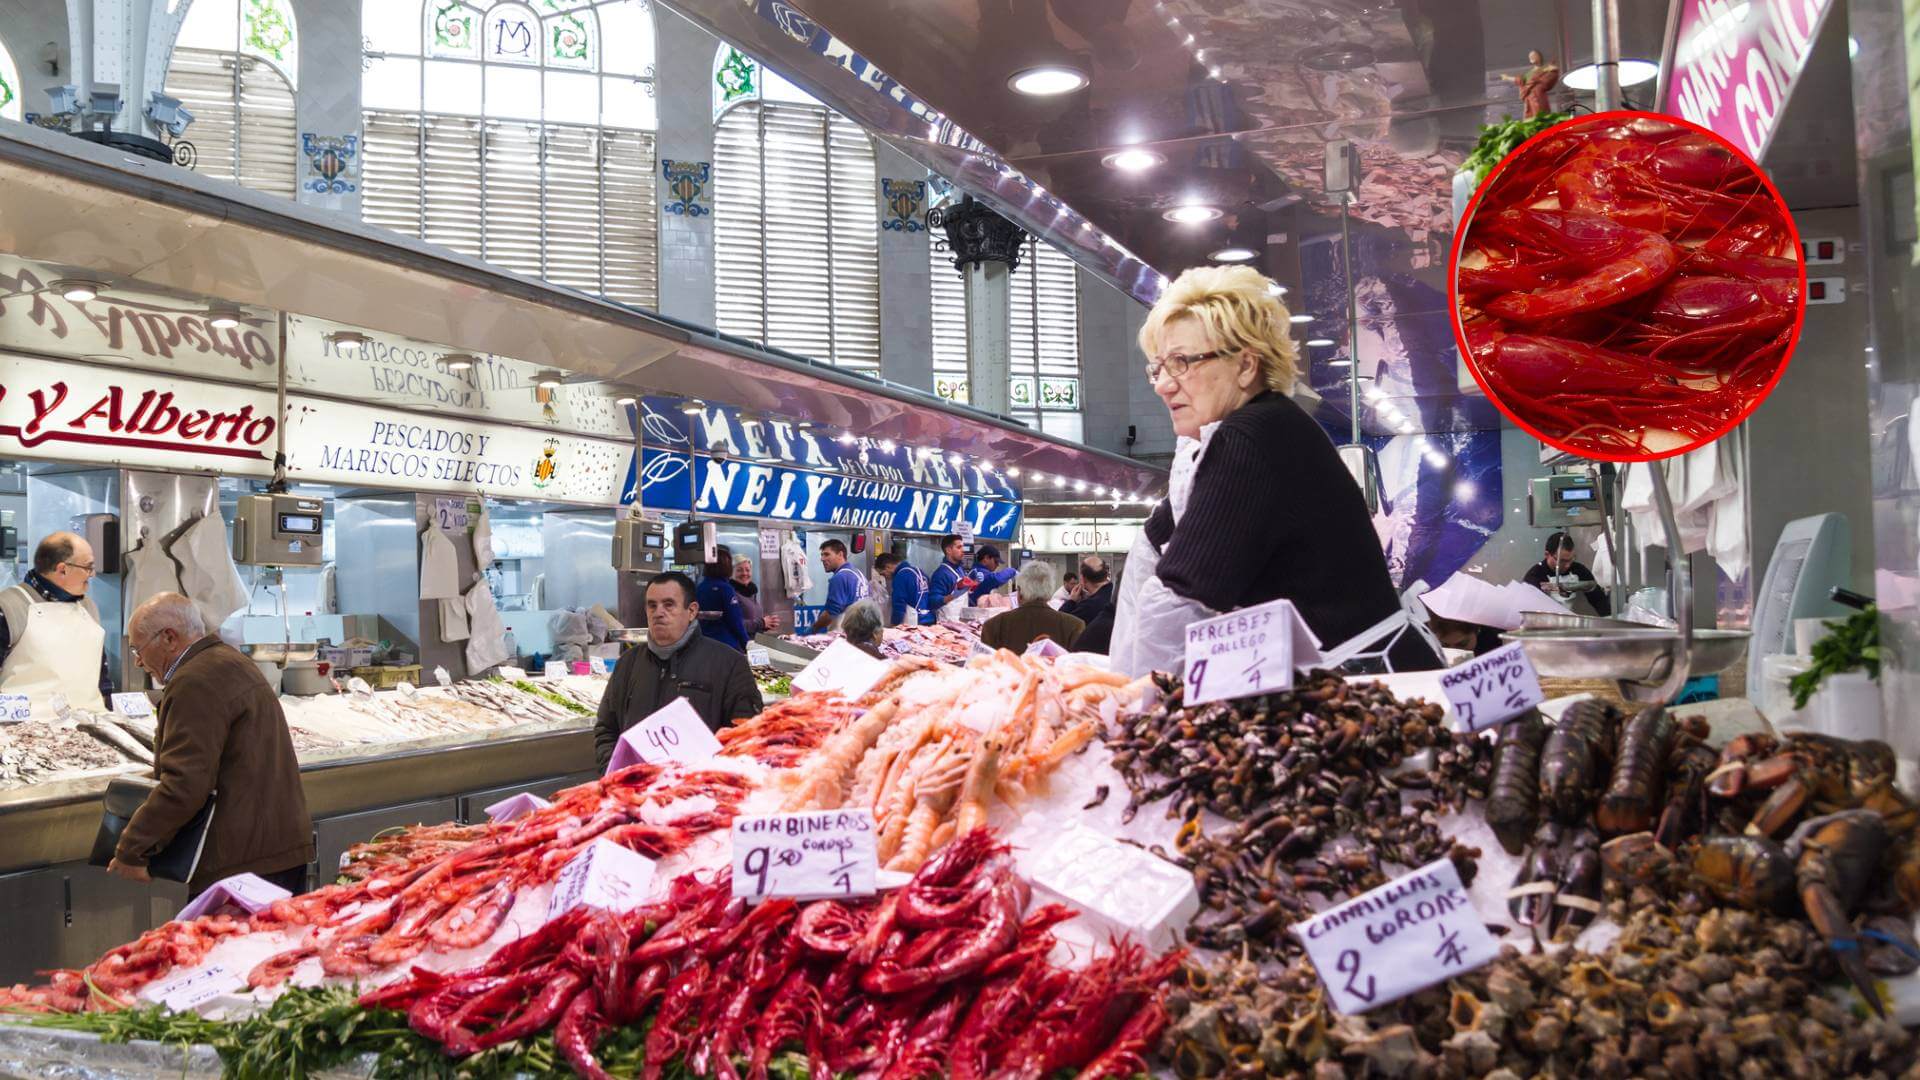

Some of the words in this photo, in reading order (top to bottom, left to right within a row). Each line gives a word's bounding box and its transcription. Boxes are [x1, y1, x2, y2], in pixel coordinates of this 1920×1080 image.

[68, 385, 276, 445] Alberto
[370, 421, 474, 455] PESCADOS
[478, 434, 491, 457] Y
[319, 445, 430, 478] MARISCOS
[433, 457, 522, 487] SELECTOS
[695, 459, 833, 519] NELY
[839, 478, 906, 504] PESCADOS
[831, 506, 897, 529] MARISCOS
[1189, 612, 1272, 642] PERCEBES
[1211, 632, 1266, 655] GALLEGO
[1188, 658, 1208, 701] 9
[1442, 646, 1522, 689] BOGAVANTE
[1455, 702, 1475, 732] 7
[646, 725, 679, 756] 40
[739, 813, 870, 837] CARBINEROS
[1335, 949, 1377, 1003] 2
